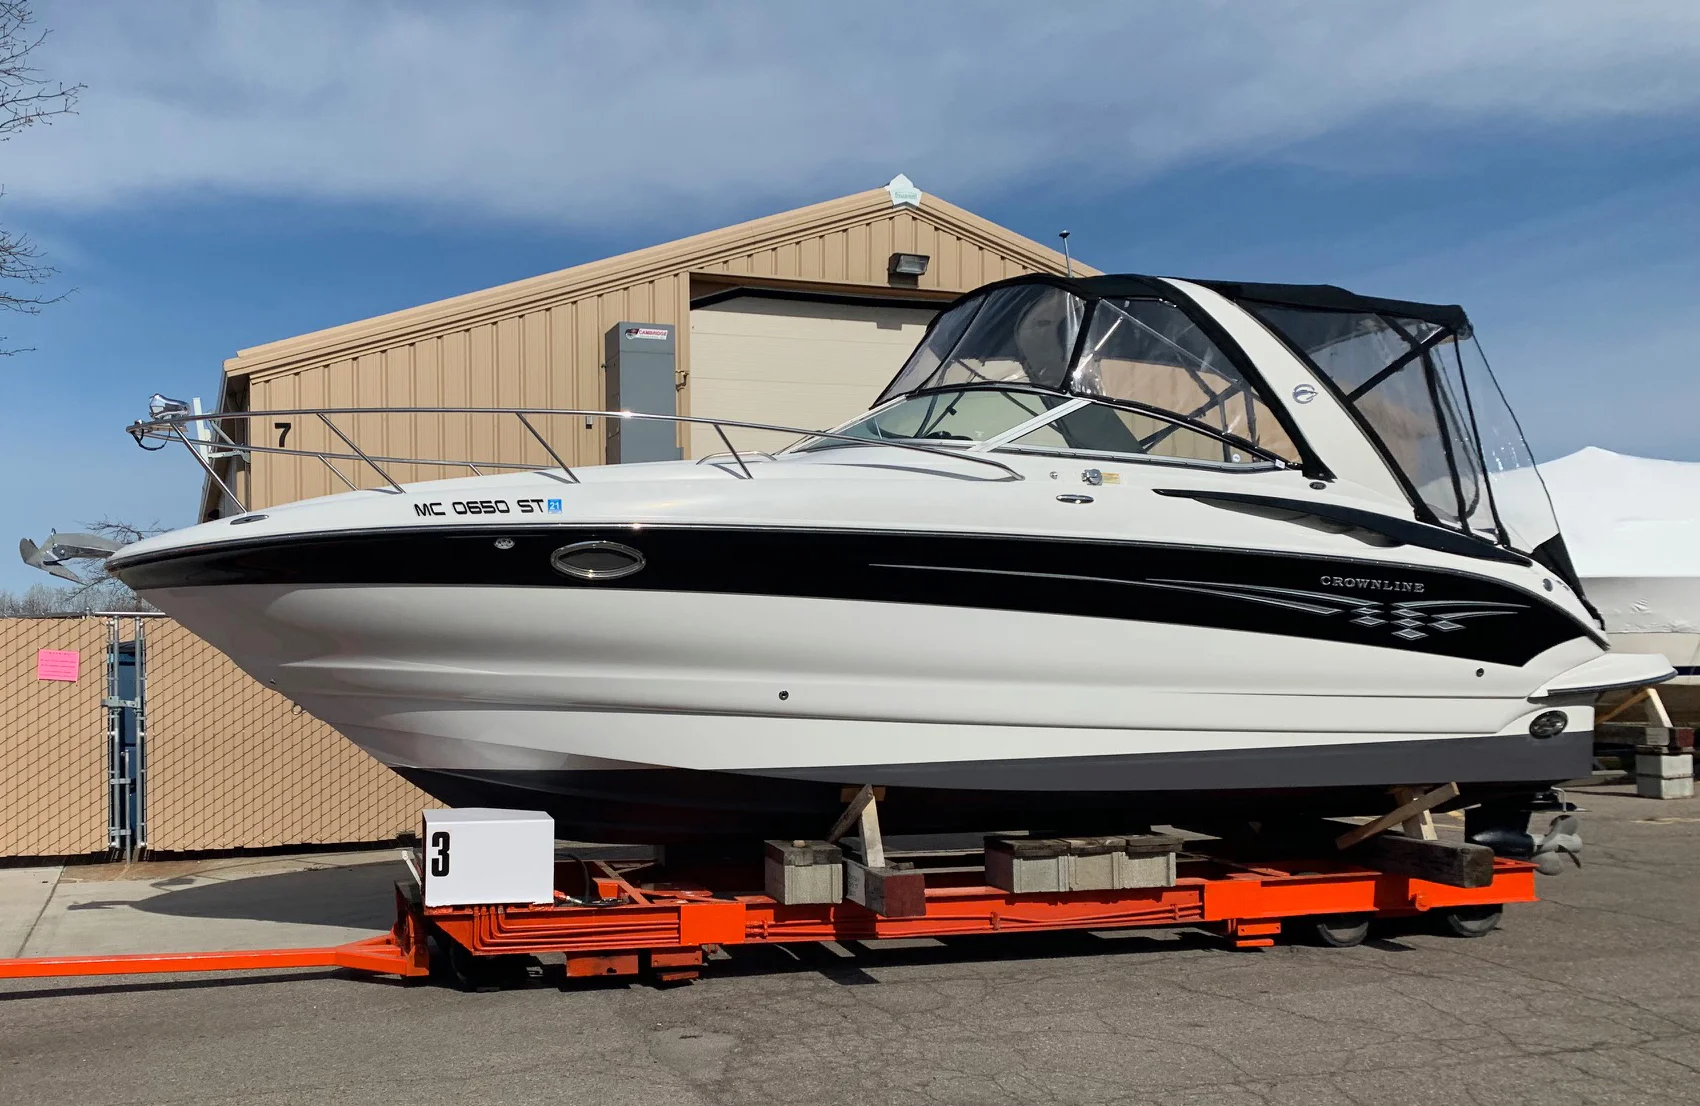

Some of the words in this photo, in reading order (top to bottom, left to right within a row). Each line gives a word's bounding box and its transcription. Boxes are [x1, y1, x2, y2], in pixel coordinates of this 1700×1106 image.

[274, 422, 292, 448] 7
[413, 502, 446, 517] MC
[452, 499, 510, 515] 0650
[516, 498, 544, 513] ST
[549, 501, 560, 510] 21
[1320, 575, 1425, 593] CROWNLINE
[431, 831, 450, 877] 3
